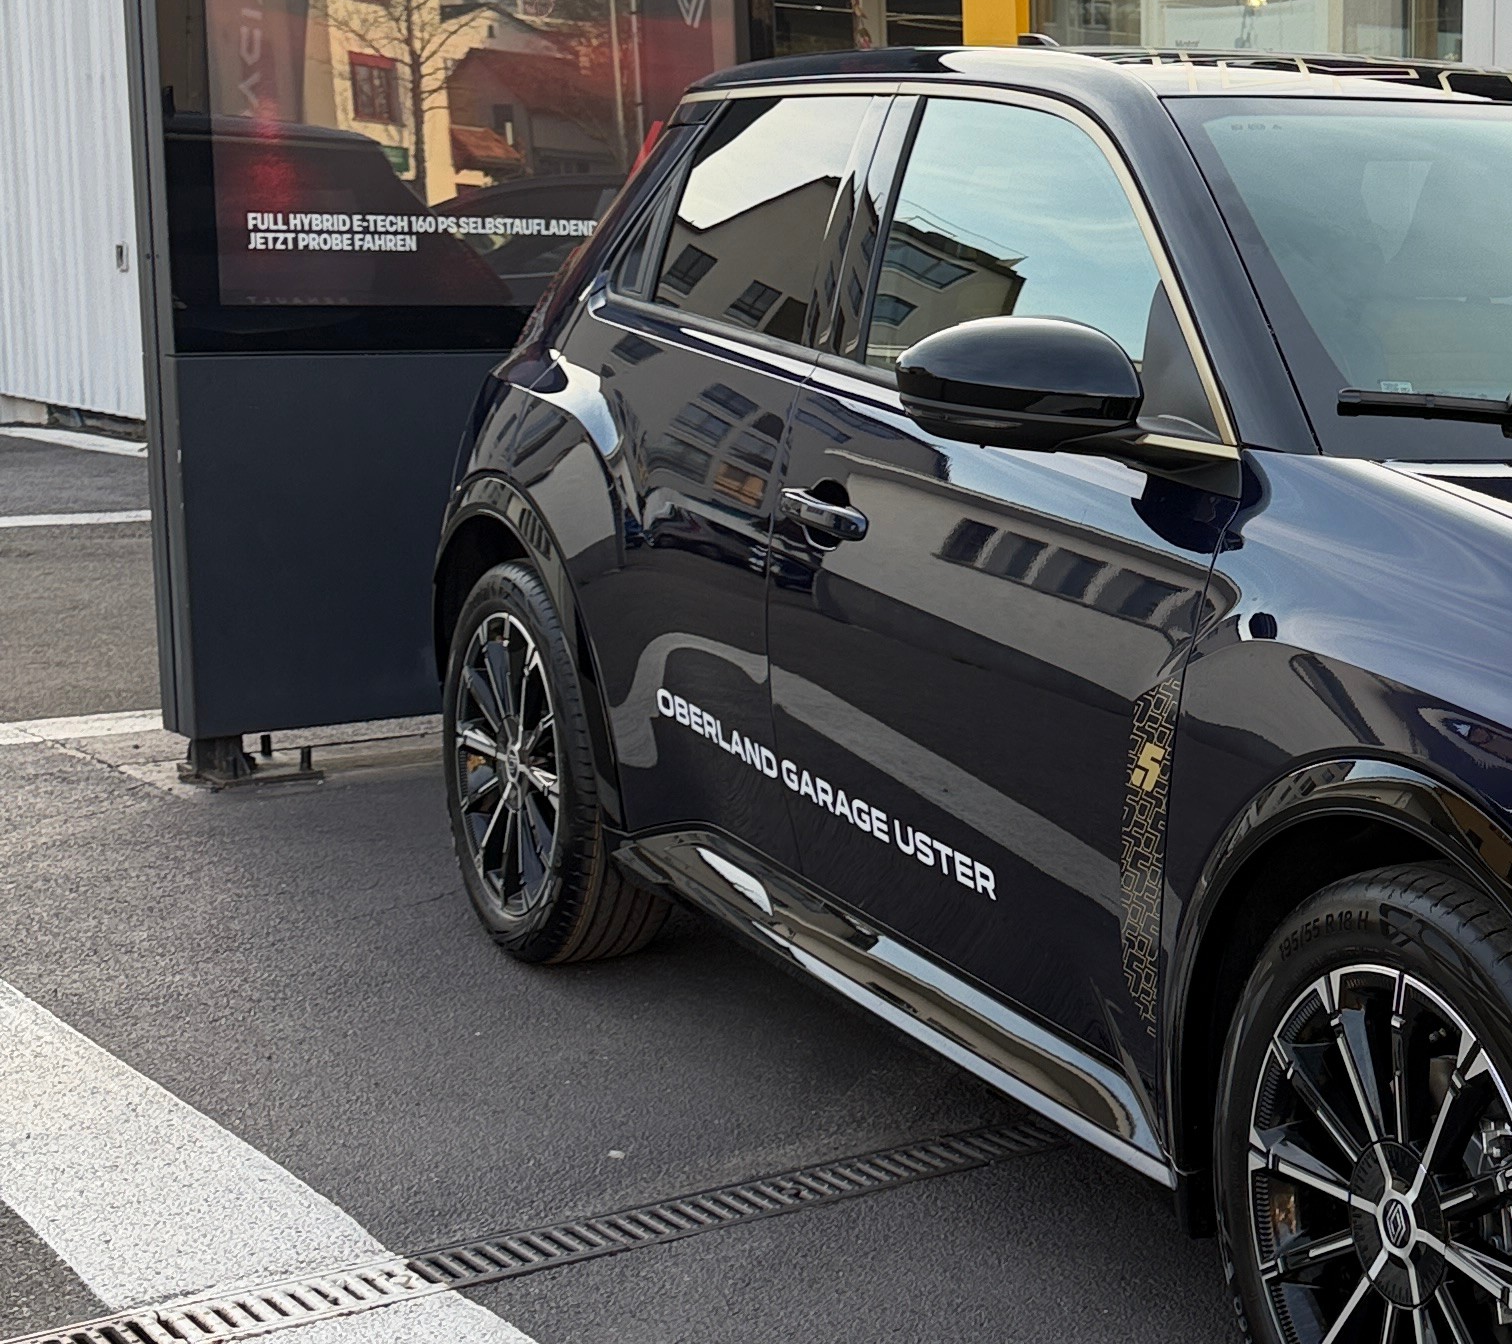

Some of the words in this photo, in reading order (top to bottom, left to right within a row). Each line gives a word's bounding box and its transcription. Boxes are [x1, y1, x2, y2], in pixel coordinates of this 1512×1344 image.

[247, 212, 288, 231] FULL
[289, 213, 350, 232] HYBRID
[352, 214, 410, 233] E-TECH
[410, 215, 436, 234] 160
[438, 216, 458, 234] PS
[248, 232, 296, 251] JETZT
[297, 233, 353, 251] PROBE
[354, 234, 418, 252] FAHREN
[656, 688, 778, 780] OBERLAND
[781, 759, 891, 844] GARAGE
[893, 819, 997, 901] USTER
[1278, 915, 1321, 961] 195/55
